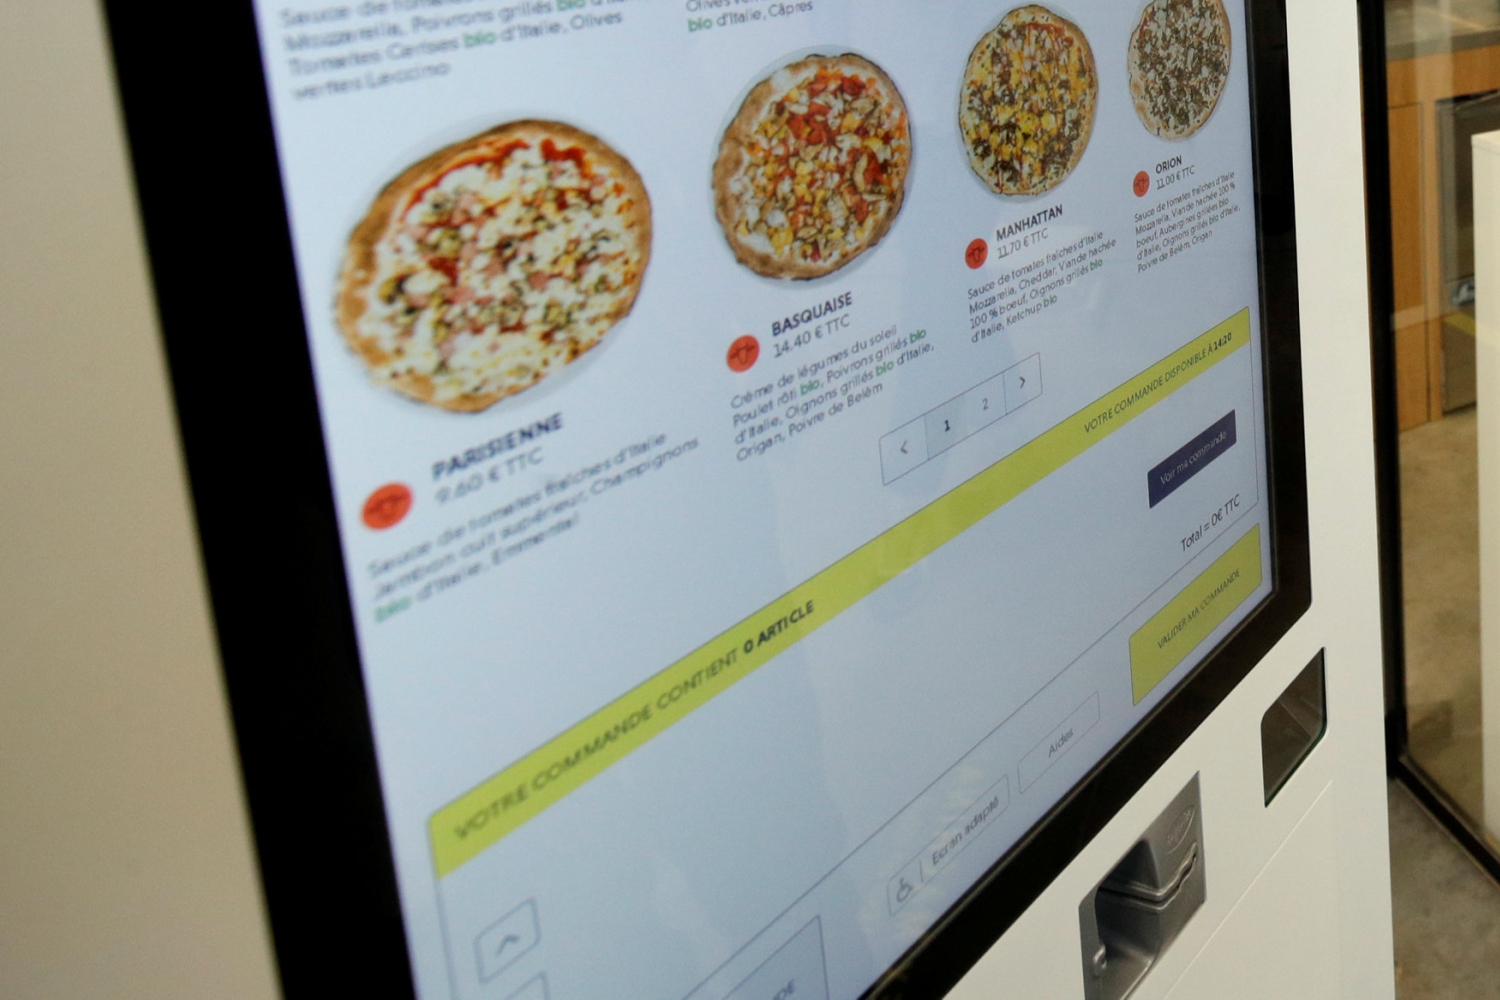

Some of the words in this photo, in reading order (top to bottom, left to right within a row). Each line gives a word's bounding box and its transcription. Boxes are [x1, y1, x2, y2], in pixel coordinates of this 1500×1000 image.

[688, 18, 713, 33] bio
[716, 10, 766, 27] d'Italie,
[1156, 156, 1182, 174] ORION
[1156, 174, 1175, 190] 11.00
[1176, 169, 1183, 180] €
[1182, 165, 1194, 178] TTC
[996, 205, 1062, 241] MANHATTAN
[997, 240, 1021, 259] 11.70
[1023, 236, 1028, 247] €
[1030, 227, 1048, 244] TTC
[968, 282, 995, 300] Sauce
[998, 274, 1010, 285] de
[1011, 260, 1045, 280] tomates
[1046, 242, 1079, 264] fraîches
[1077, 232, 1103, 250] d'Italie
[772, 292, 852, 337] BASQUAISE
[774, 331, 811, 358] 14.40
[815, 325, 822, 339] €
[825, 313, 850, 334] TTC
[972, 323, 1004, 343] d'Italie,
[1006, 300, 1044, 326] Ketchup
[1043, 295, 1057, 308] bio
[731, 384, 773, 409] Crème
[778, 375, 794, 388] de
[798, 349, 849, 378] légumes
[851, 341, 867, 354] du
[869, 325, 896, 346] soleil
[733, 400, 773, 427] Poulet
[777, 390, 797, 406] rôti
[800, 380, 823, 396] bio,
[827, 355, 874, 383] Poivrons
[875, 337, 908, 363] grillés
[909, 330, 926, 344] bio
[735, 418, 782, 444] d'Italie,
[785, 389, 837, 419] Oignons
[840, 371, 873, 396] grillés
[875, 361, 894, 377] bio
[897, 344, 934, 366] d'Italie,
[1084, 408, 1112, 434] VOTRE
[1114, 376, 1163, 414] COMMANDE
[1164, 348, 1206, 382] DISPONIBLE
[1208, 343, 1214, 354] À
[737, 434, 785, 461] Origan,
[788, 412, 824, 436] Poivre
[828, 403, 844, 416] de
[944, 419, 951, 432] 1
[982, 398, 989, 410] 2
[432, 412, 564, 480] PARISIENNE
[1160, 469, 1175, 484] Voir
[1177, 459, 1190, 473] ma
[1189, 430, 1227, 463] commande
[1180, 525, 1202, 552] Total
[1224, 494, 1240, 515] TTC
[1158, 618, 1186, 649] VALIDER
[1188, 607, 1200, 622] MA
[1200, 568, 1240, 610] COMMANDE
[454, 785, 529, 840] VOTRE
[531, 706, 652, 790] COMMANDE
[656, 648, 738, 710] CONTIENT
[743, 638, 754, 656] 0
[757, 600, 814, 648] ARTICLE
